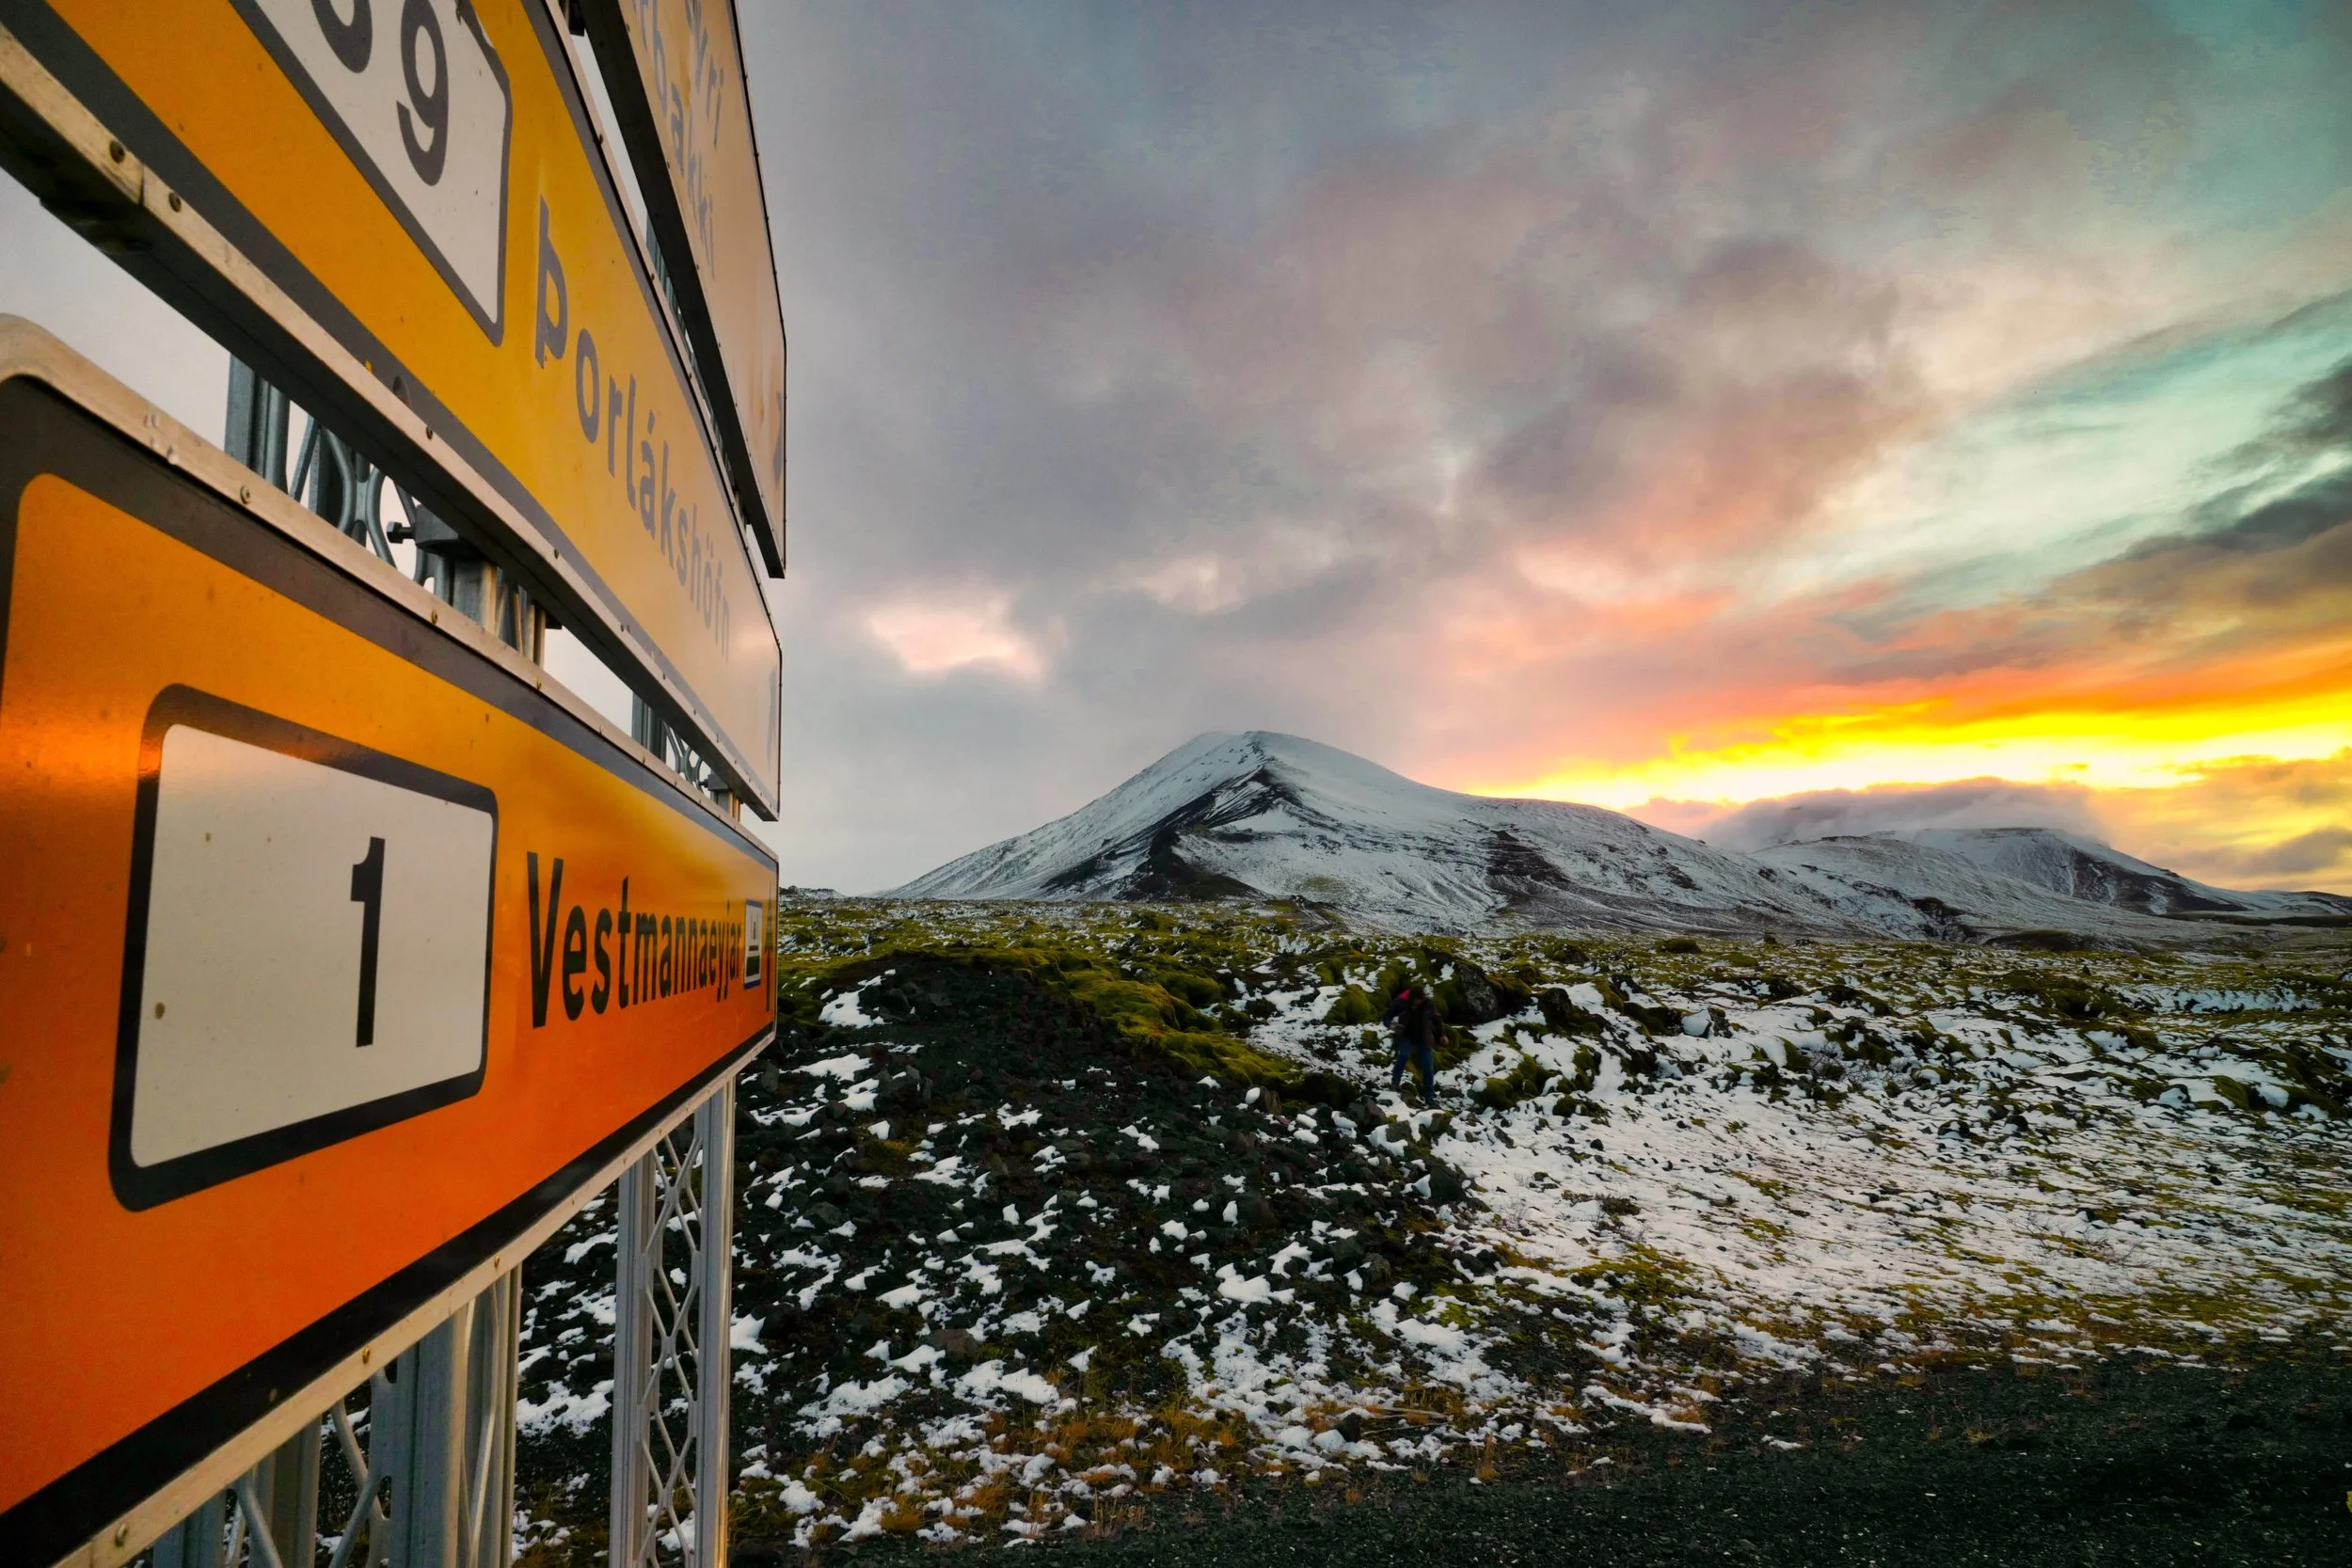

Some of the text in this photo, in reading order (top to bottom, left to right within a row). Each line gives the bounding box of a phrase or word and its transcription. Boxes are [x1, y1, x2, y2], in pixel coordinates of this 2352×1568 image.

[534, 194, 730, 662] Þorlákshöfn
[350, 835, 741, 1048] 1 Vestmannaeyjar
